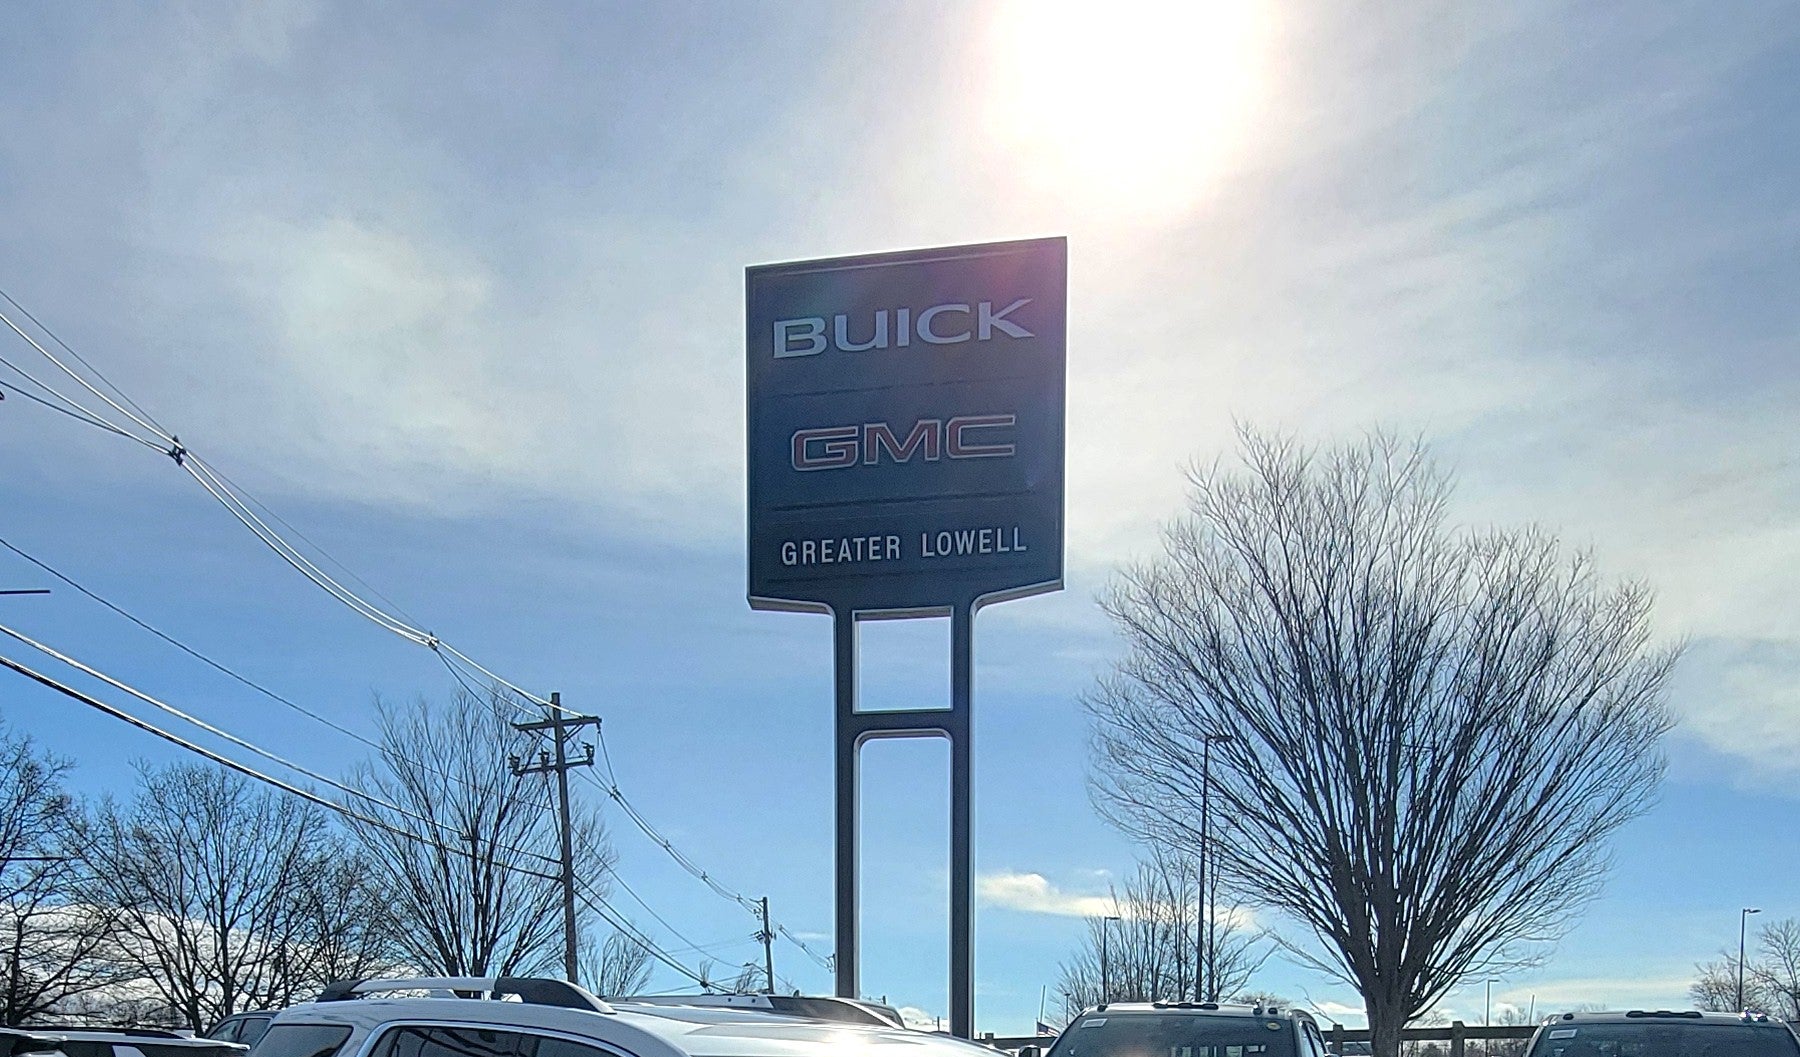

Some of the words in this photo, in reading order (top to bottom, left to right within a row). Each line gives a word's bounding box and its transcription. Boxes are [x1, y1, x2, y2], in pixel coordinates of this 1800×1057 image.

[773, 298, 1035, 359] BUICK
[791, 414, 1016, 471] GMC
[781, 535, 901, 566] GREATER
[921, 526, 1027, 558] LOWELL
